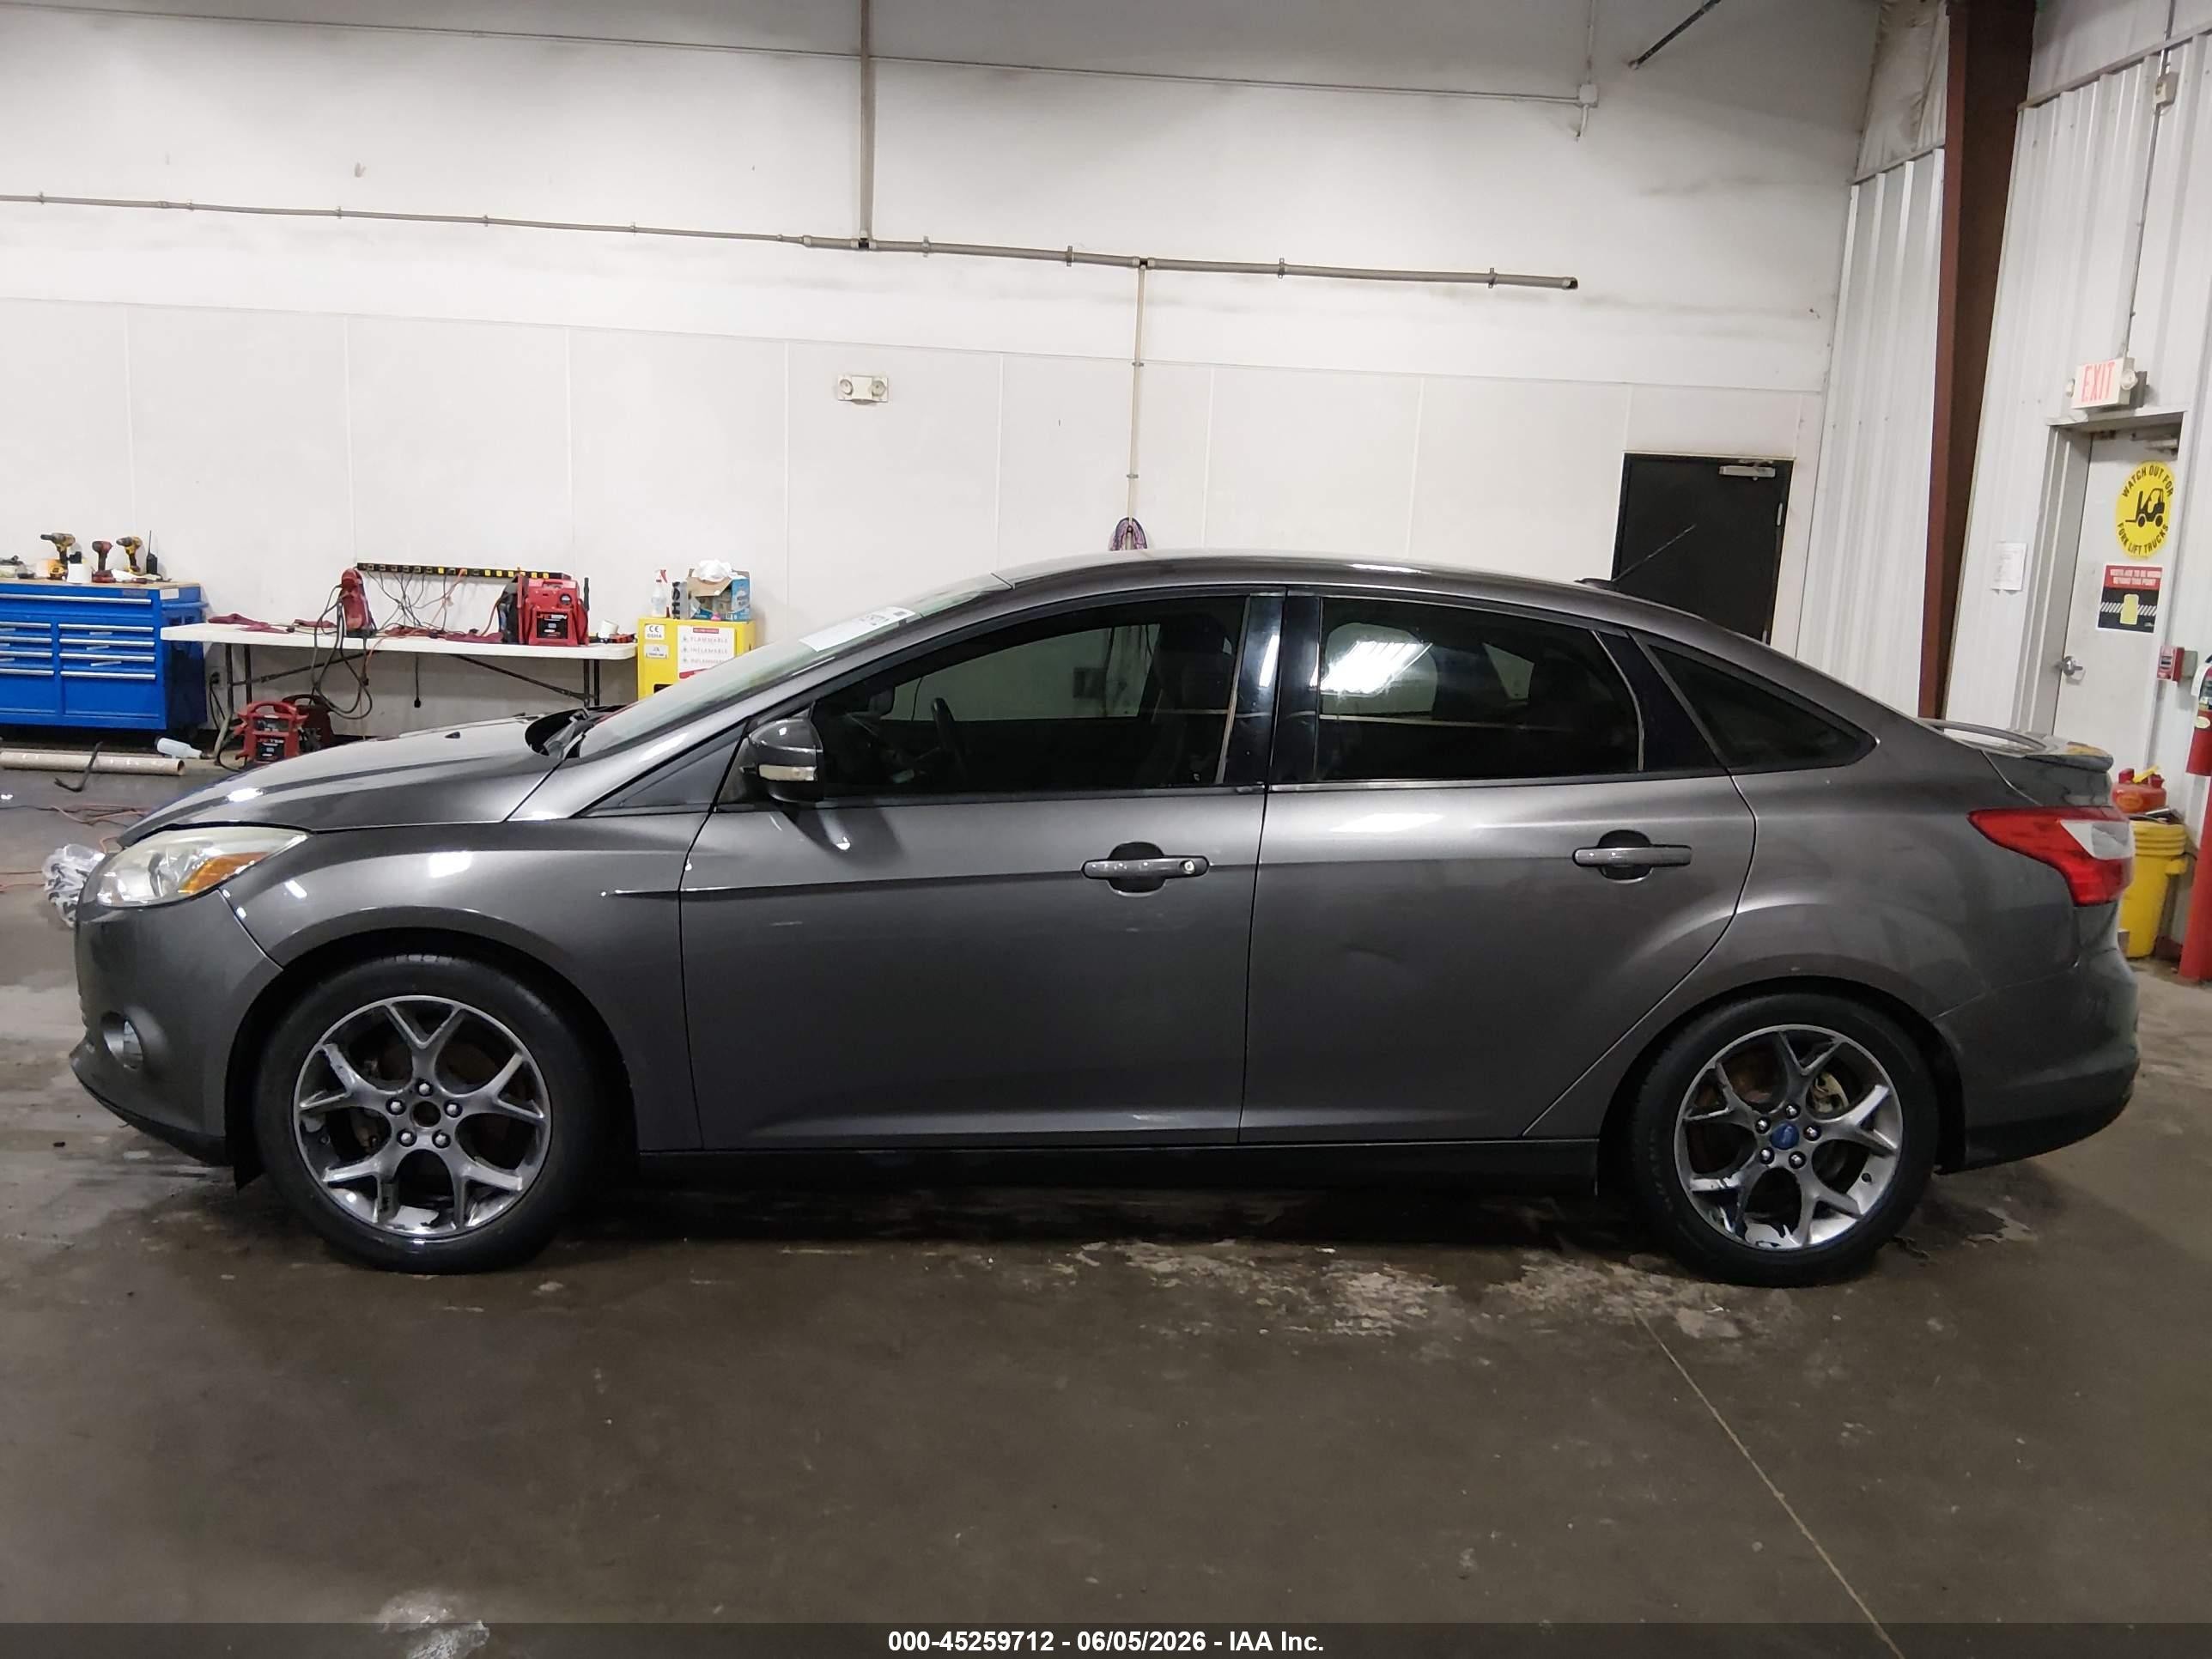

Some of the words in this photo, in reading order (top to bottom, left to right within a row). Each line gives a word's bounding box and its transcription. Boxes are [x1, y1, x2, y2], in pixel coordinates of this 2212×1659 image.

[2081, 361, 2116, 403] EXIT
[2122, 466, 2147, 497] WATCH
[2148, 465, 2164, 479] OUT
[2162, 474, 2174, 497] FOR
[2118, 522, 2130, 548] FORK
[2128, 542, 2142, 556] LIFT
[2144, 524, 2169, 554] TRUCKS
